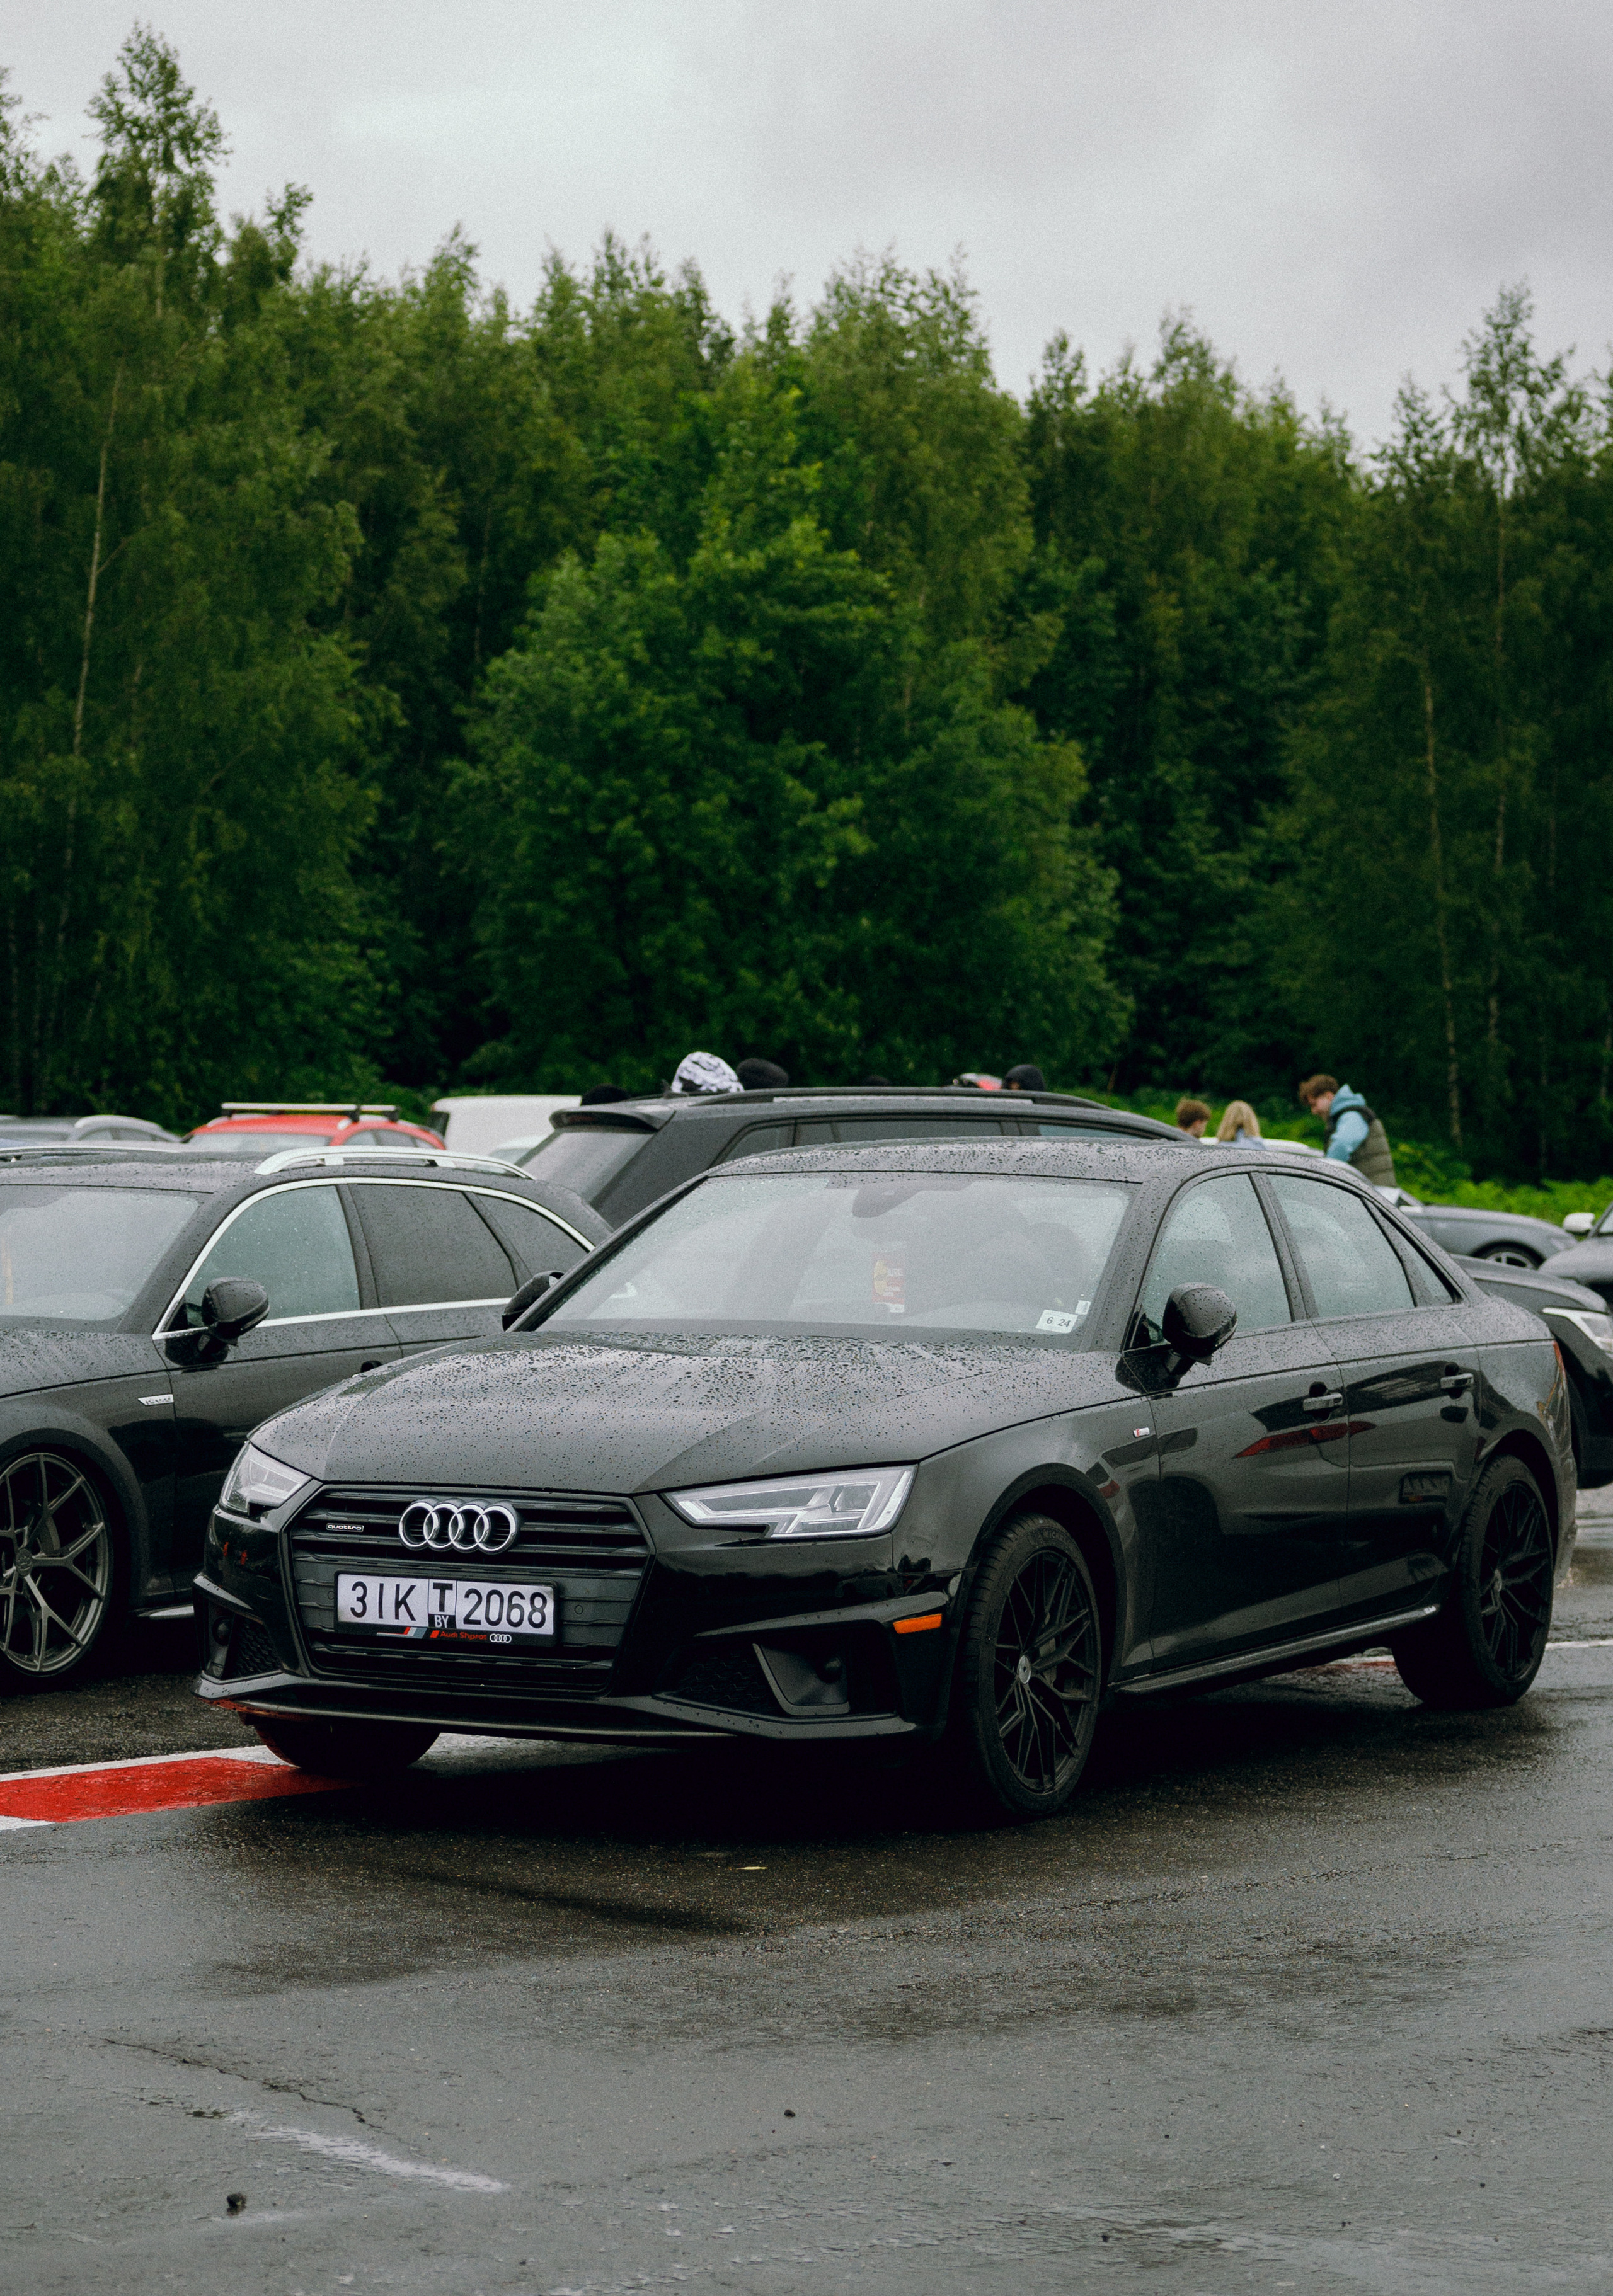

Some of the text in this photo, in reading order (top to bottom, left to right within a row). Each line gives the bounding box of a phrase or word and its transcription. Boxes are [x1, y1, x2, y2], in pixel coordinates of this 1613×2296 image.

[1046, 1316, 1071, 1328] 6 24
[350, 1580, 548, 1630] 3IK T 2068
[435, 1615, 449, 1628] BY
